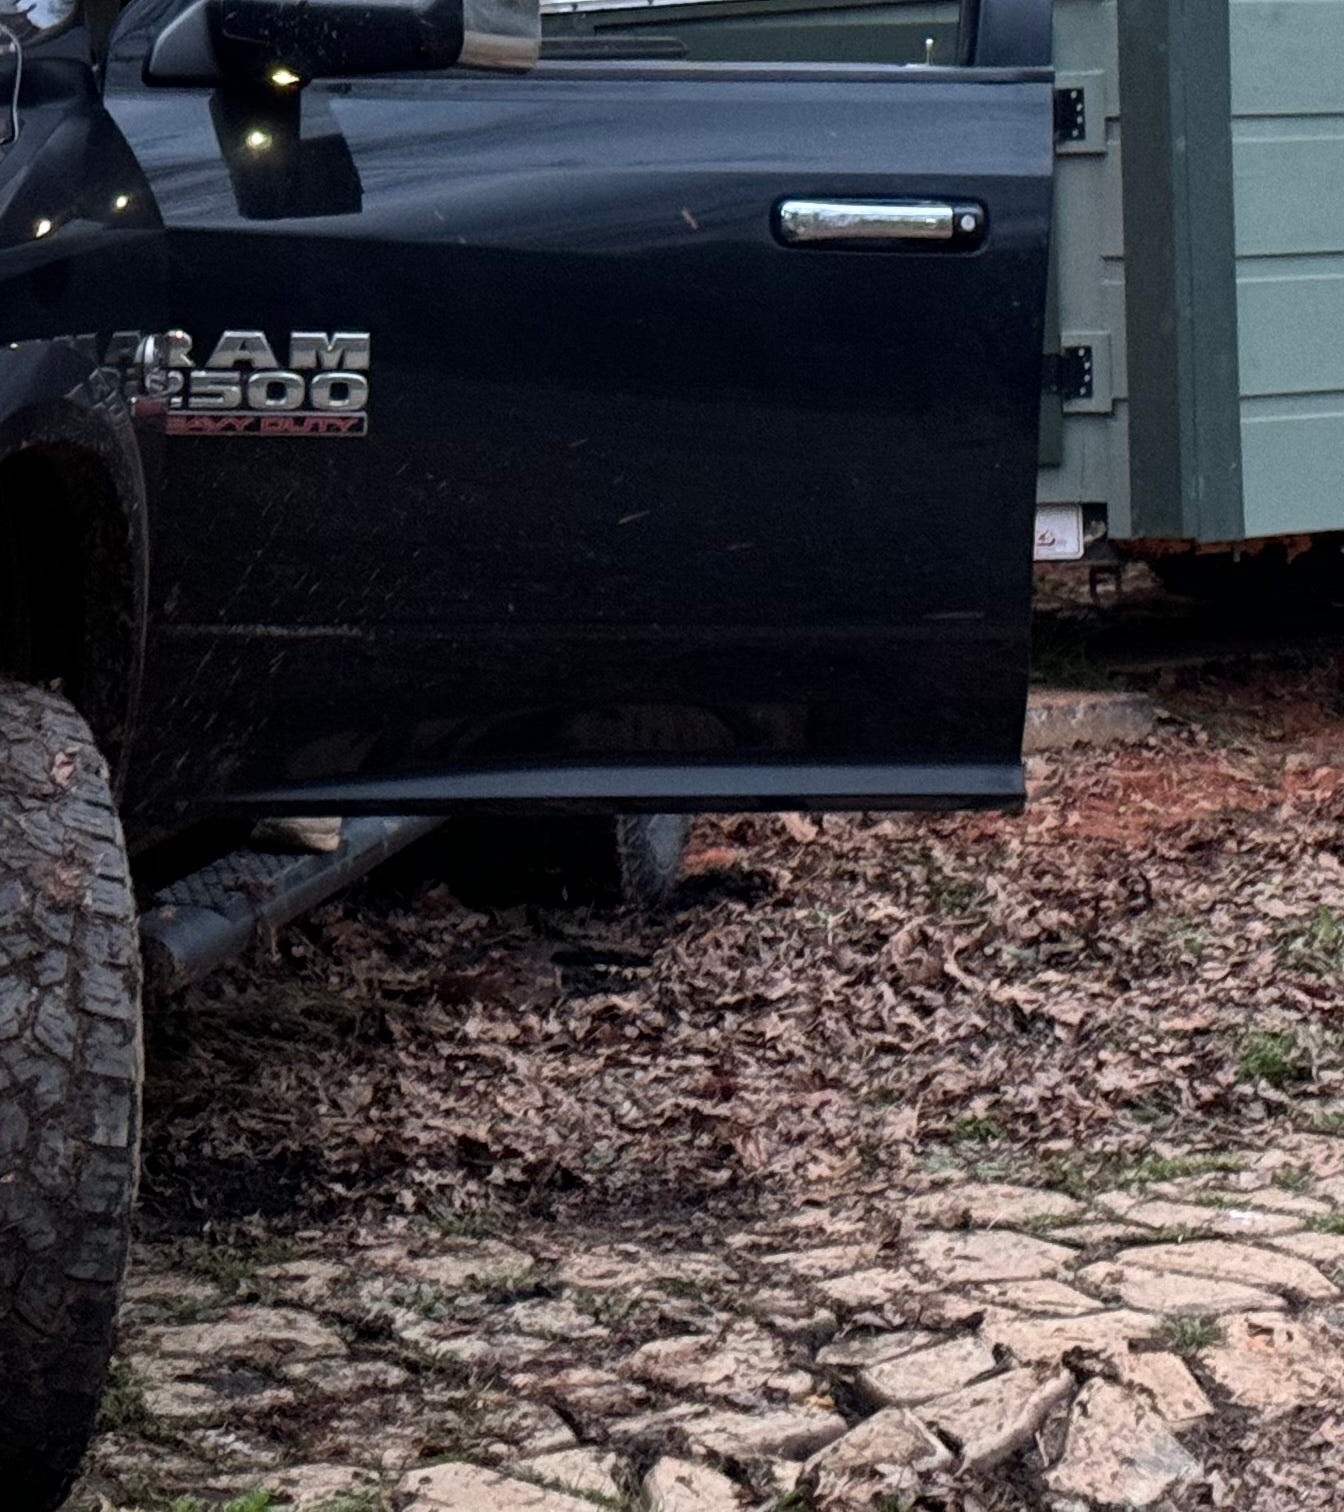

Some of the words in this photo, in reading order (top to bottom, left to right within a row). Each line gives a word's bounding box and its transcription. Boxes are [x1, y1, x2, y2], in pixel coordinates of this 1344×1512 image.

[134, 330, 371, 369] RAM
[167, 416, 255, 434] EAVY
[260, 416, 358, 434] DUTY
